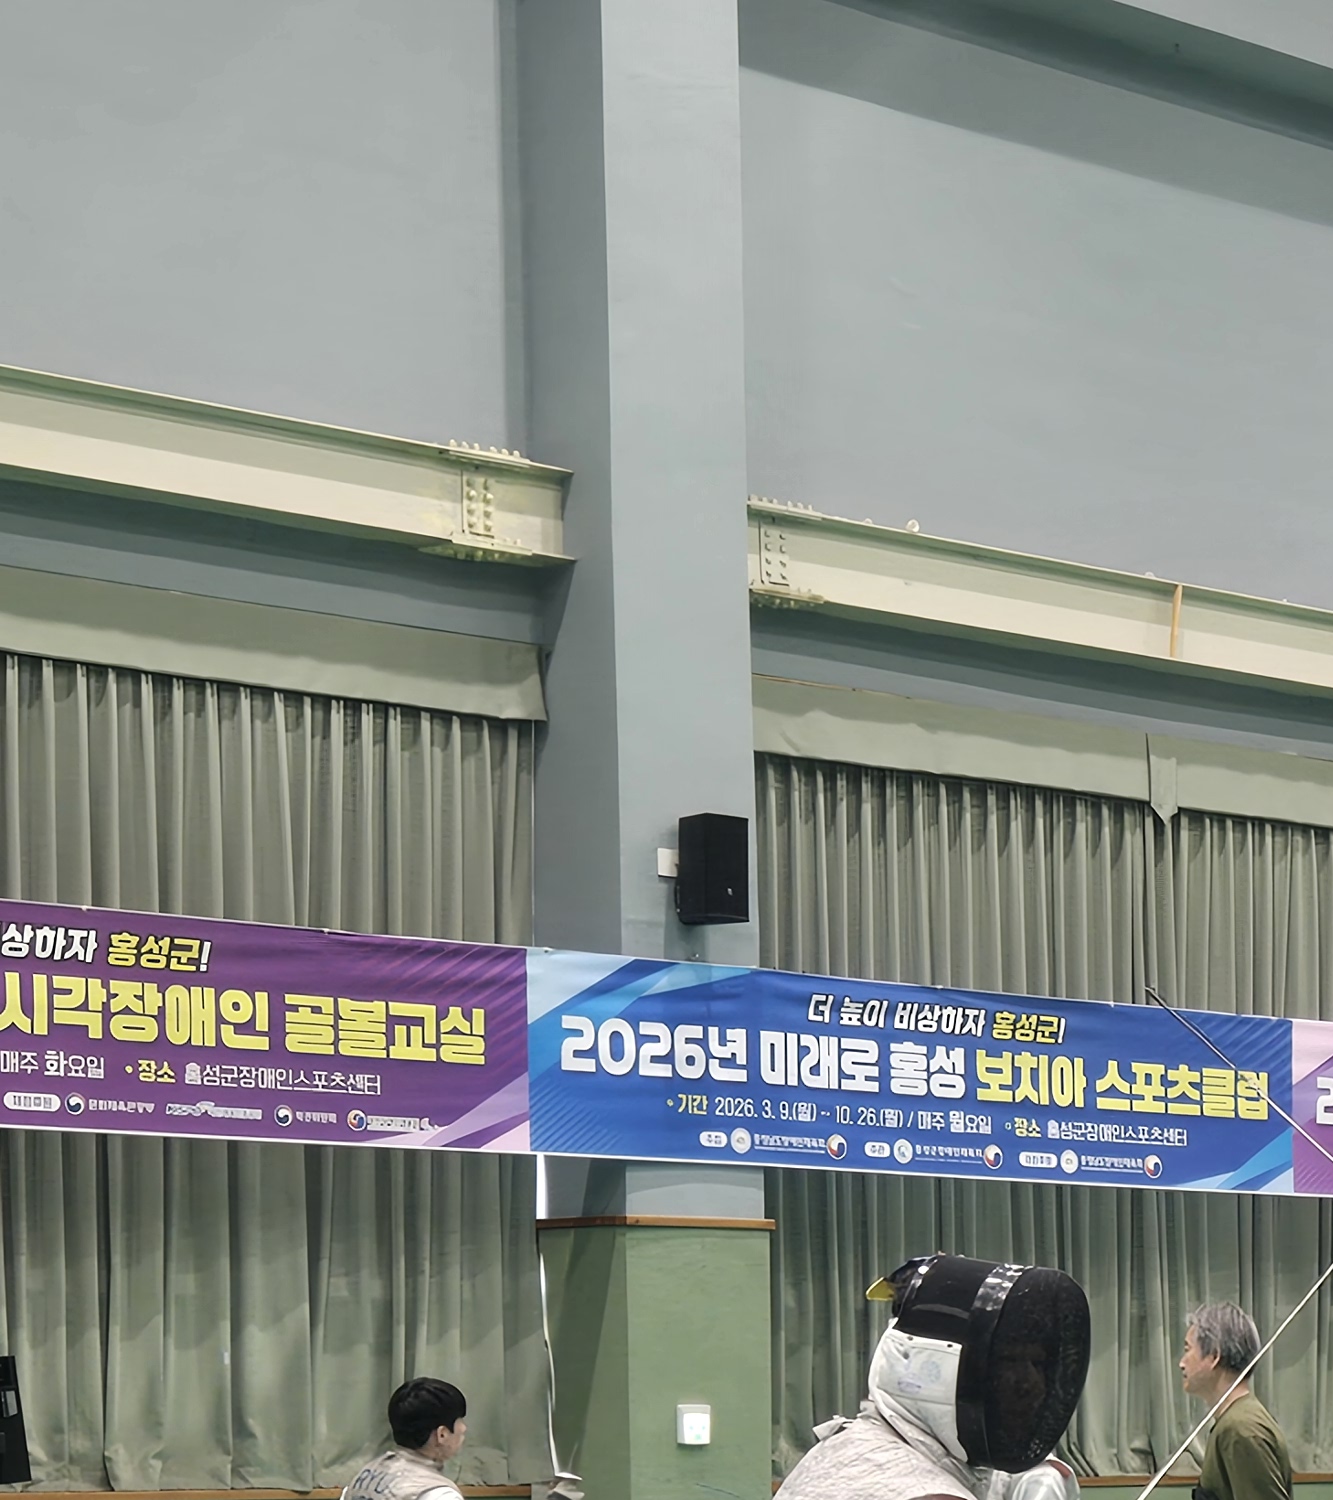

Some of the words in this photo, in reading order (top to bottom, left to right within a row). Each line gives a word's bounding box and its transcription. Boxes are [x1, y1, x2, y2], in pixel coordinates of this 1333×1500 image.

[1, 923, 98, 963] 상하자
[107, 931, 212, 972] 홍성군!
[0, 971, 270, 1051] 시각장애인
[283, 992, 486, 1066] 골볼교실
[807, 993, 834, 1023] 더
[839, 996, 888, 1028] 높이
[893, 1002, 986, 1038] 비상하자
[991, 1010, 1066, 1044] 홍성군!
[0, 1050, 39, 1075] 매주
[43, 1050, 105, 1080] 화요일
[137, 1058, 177, 1084] 장소
[560, 1014, 748, 1083] 2026년
[759, 1030, 880, 1093] 미래로
[889, 1041, 966, 1099] 홍성
[975, 1049, 1087, 1108] 보치아
[1095, 1060, 1269, 1121] 스포츠클럽
[677, 1093, 709, 1116] 기간
[714, 1096, 759, 1119] 2026.
[761, 1101, 776, 1120] 3.
[1013, 1116, 1042, 1138] 장소
